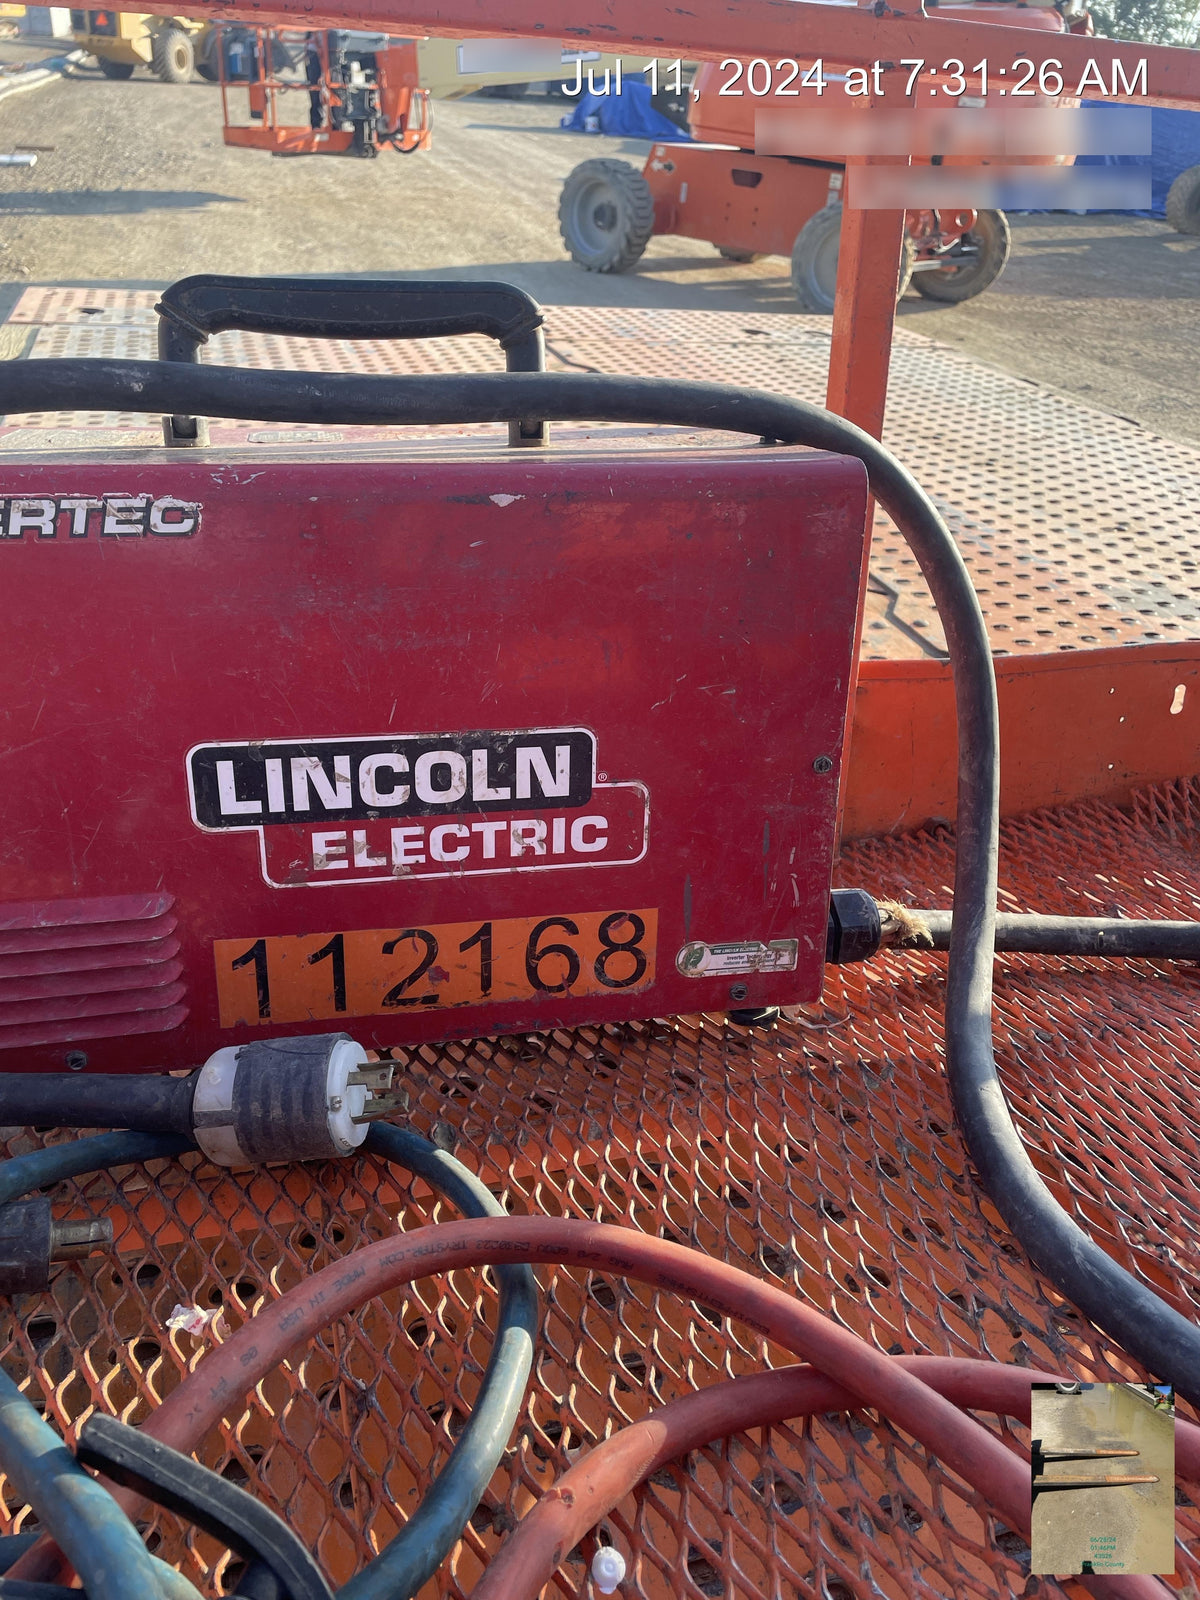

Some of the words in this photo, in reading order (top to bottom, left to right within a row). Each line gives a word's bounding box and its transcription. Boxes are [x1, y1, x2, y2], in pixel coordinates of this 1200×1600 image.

[0, 497, 203, 538] RTEC
[215, 745, 571, 815] LINCOLN
[311, 815, 609, 871] ELECTRIC
[231, 911, 647, 1019] 112168
[309, 1291, 326, 1308] IN
[331, 1267, 366, 1293] MADE
[277, 1308, 305, 1333] USA
